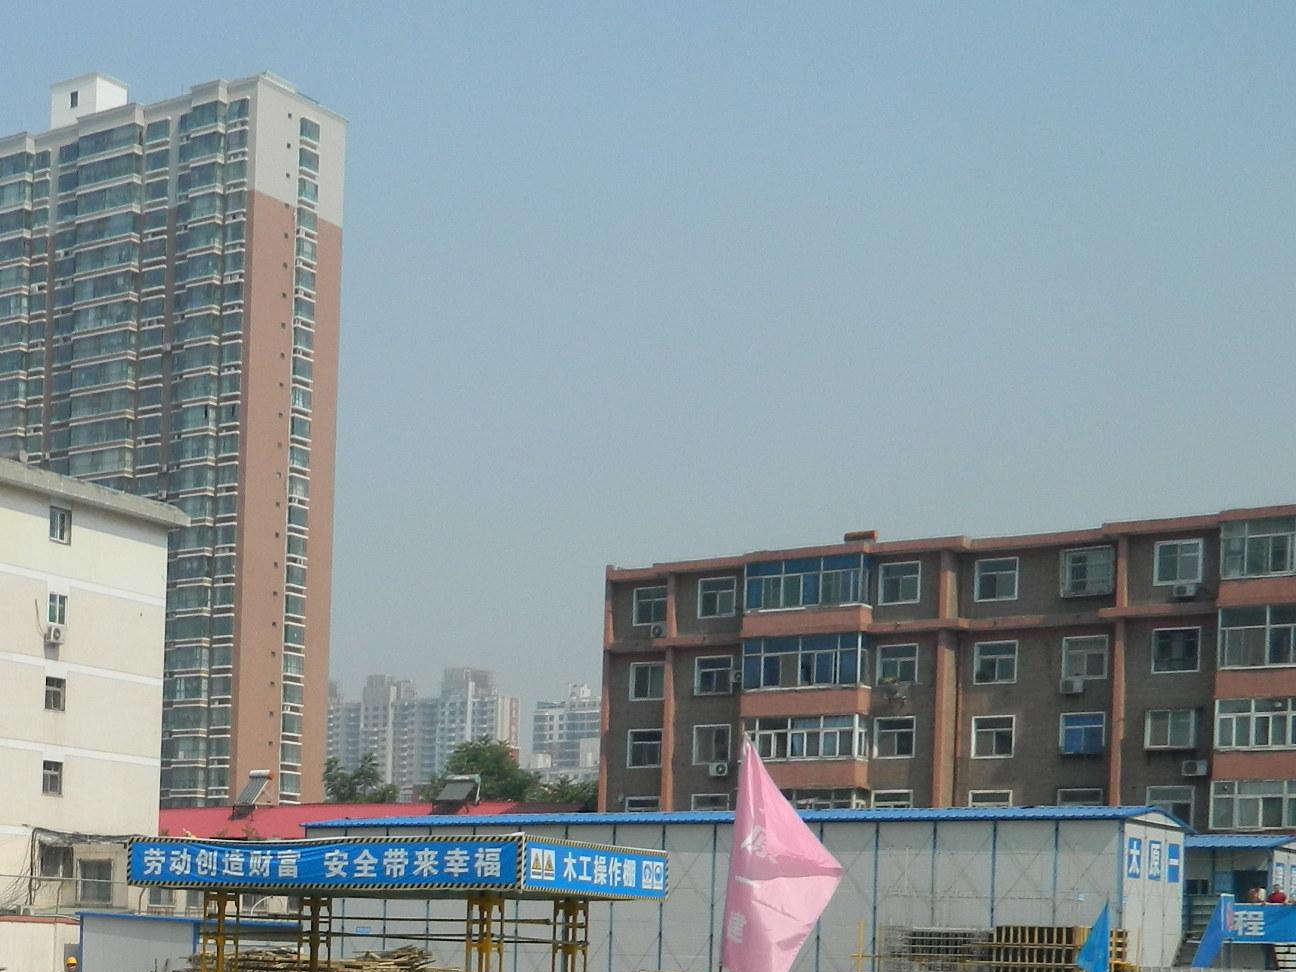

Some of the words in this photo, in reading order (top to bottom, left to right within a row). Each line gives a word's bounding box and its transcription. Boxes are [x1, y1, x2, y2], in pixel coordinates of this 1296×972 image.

[143, 848, 301, 879] 劳动创造财富
[323, 847, 502, 878] 安全带来幸福
[563, 851, 636, 888] 木工操作棚
